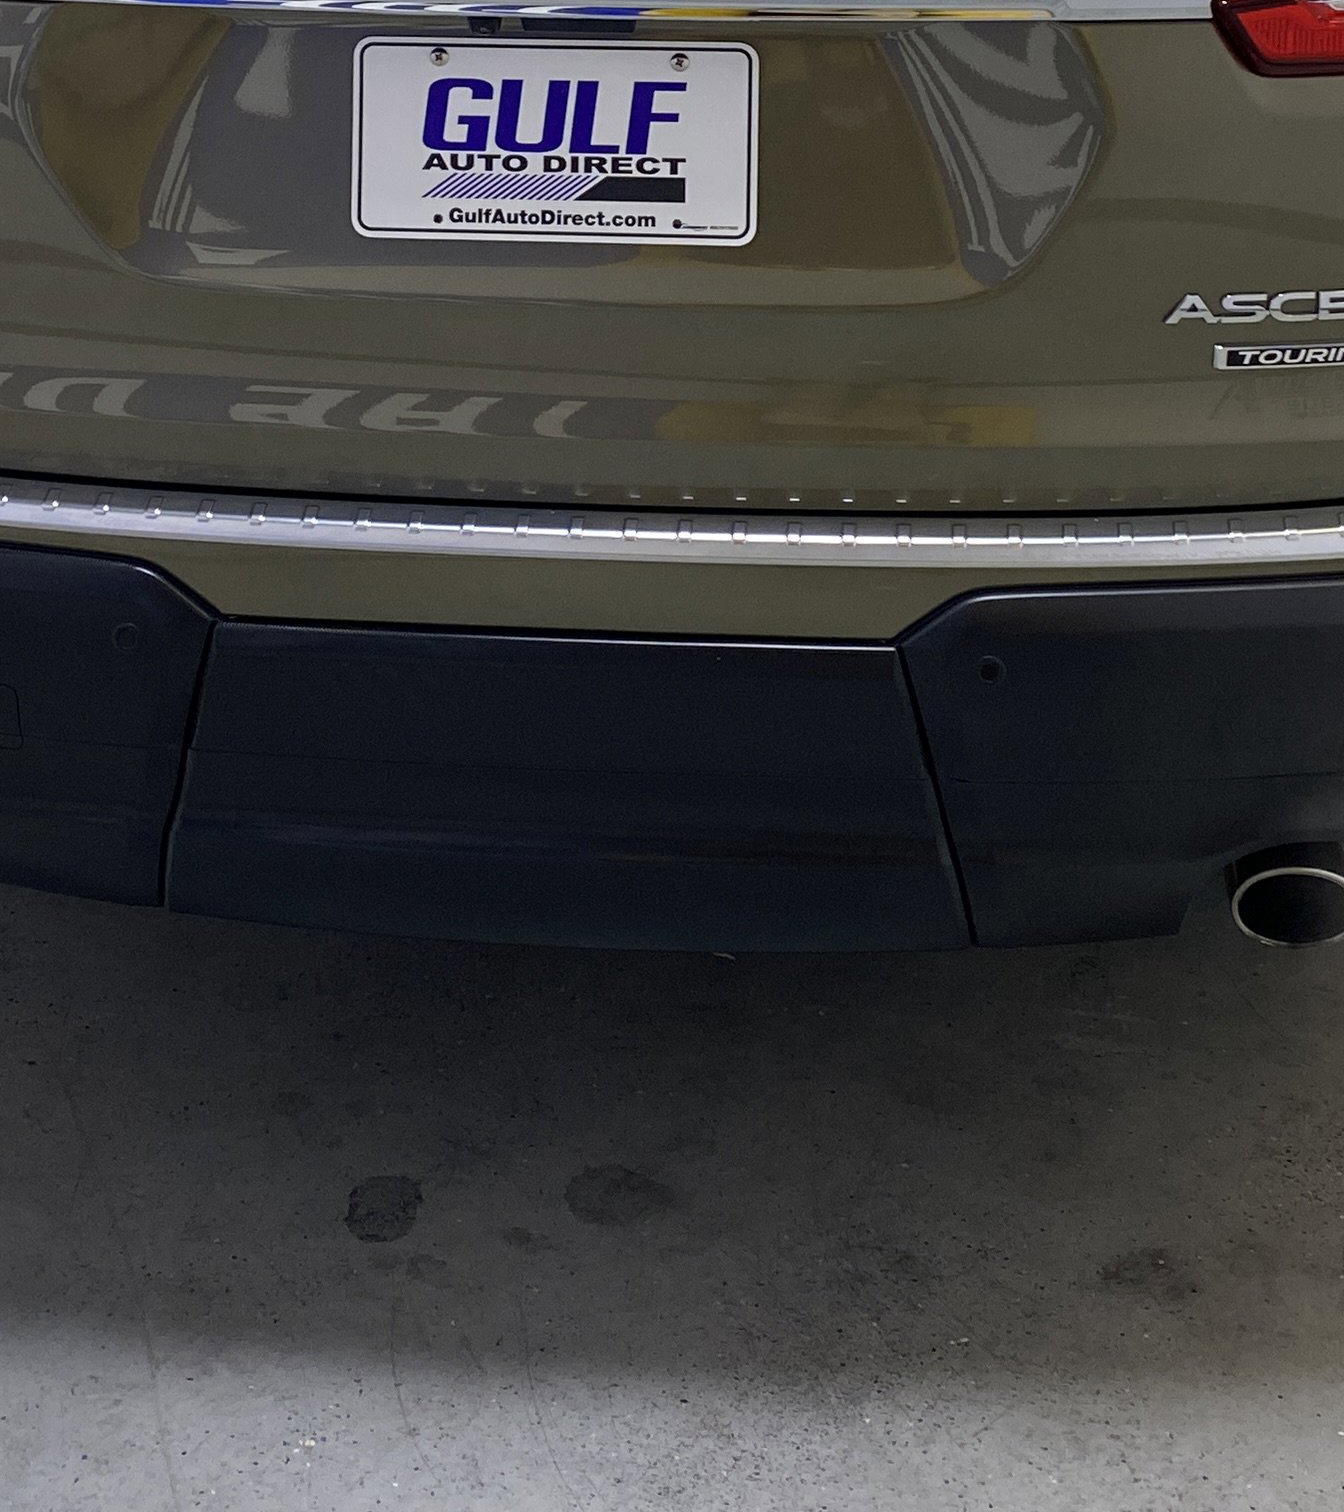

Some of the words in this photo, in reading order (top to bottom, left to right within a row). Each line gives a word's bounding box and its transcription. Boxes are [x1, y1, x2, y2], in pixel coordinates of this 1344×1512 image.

[422, 77, 688, 155] GULF
[421, 153, 529, 173] AUTO
[542, 155, 687, 176] DIRECT
[448, 207, 656, 228] GulfAutoDirect.com
